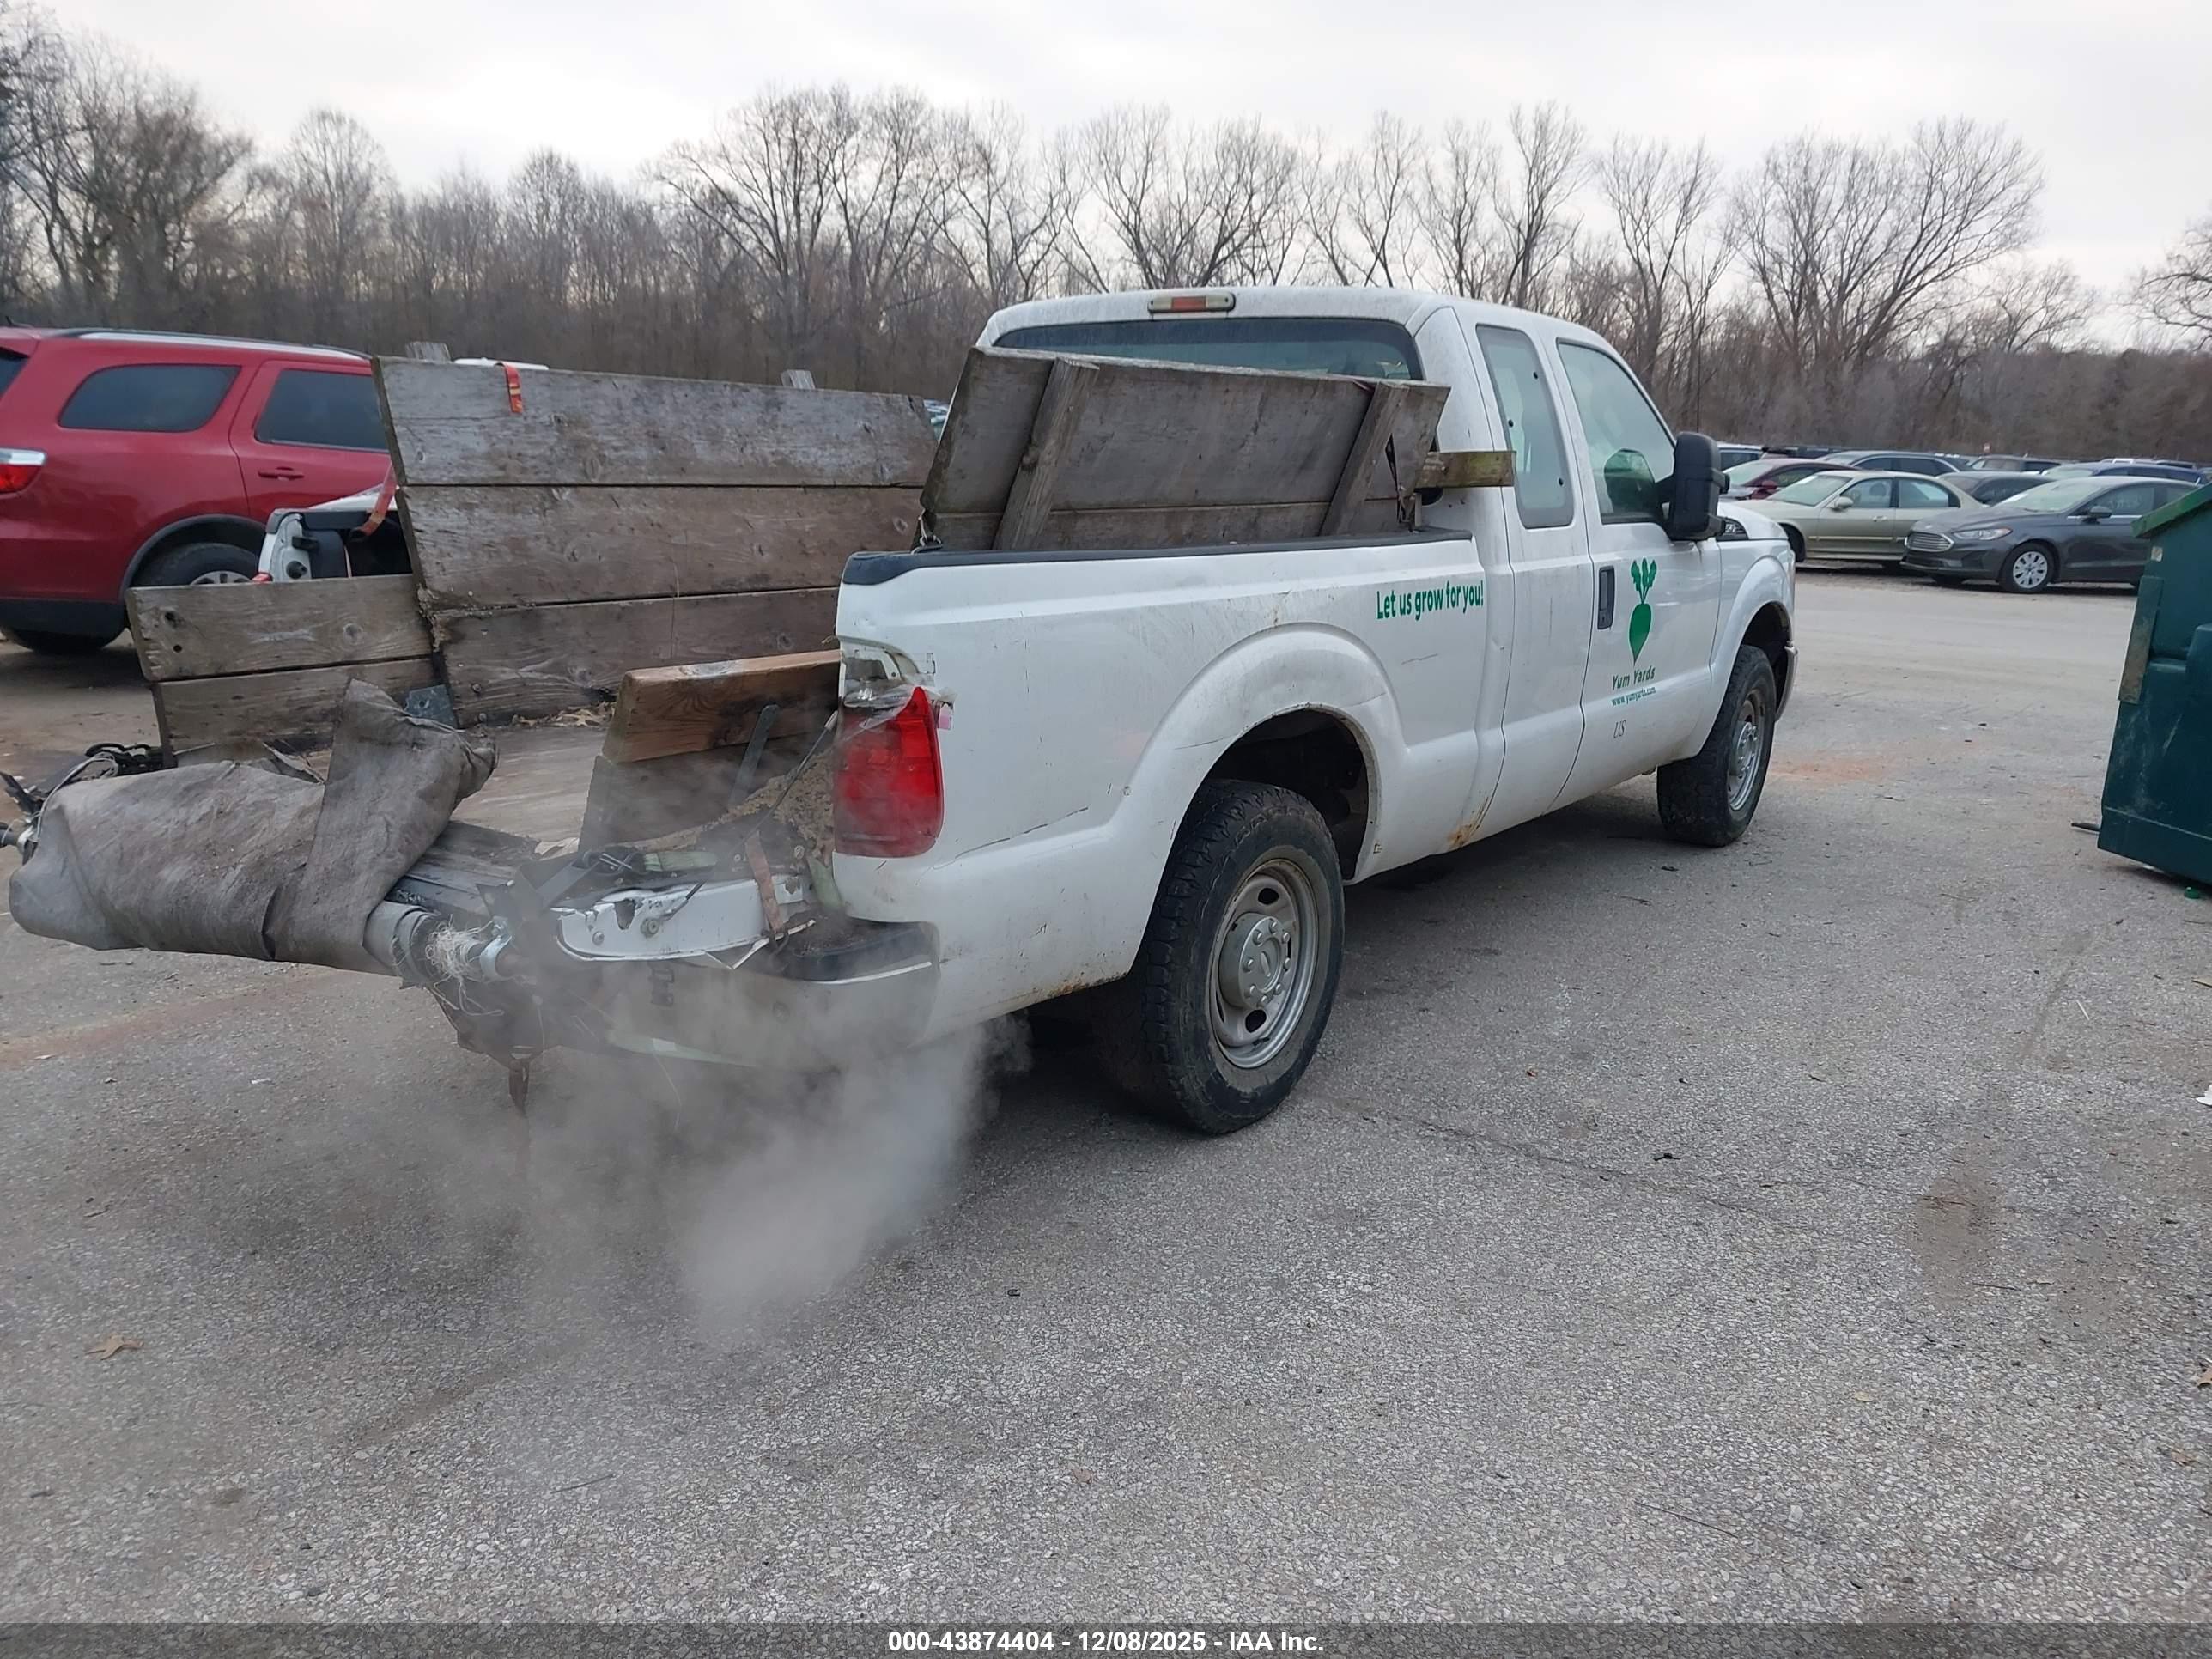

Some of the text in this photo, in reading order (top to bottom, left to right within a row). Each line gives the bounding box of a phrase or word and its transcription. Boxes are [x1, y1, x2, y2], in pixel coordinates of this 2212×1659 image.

[1376, 580, 1484, 621] Let us grow for you!
[1613, 665, 1656, 690] Yum Yards
